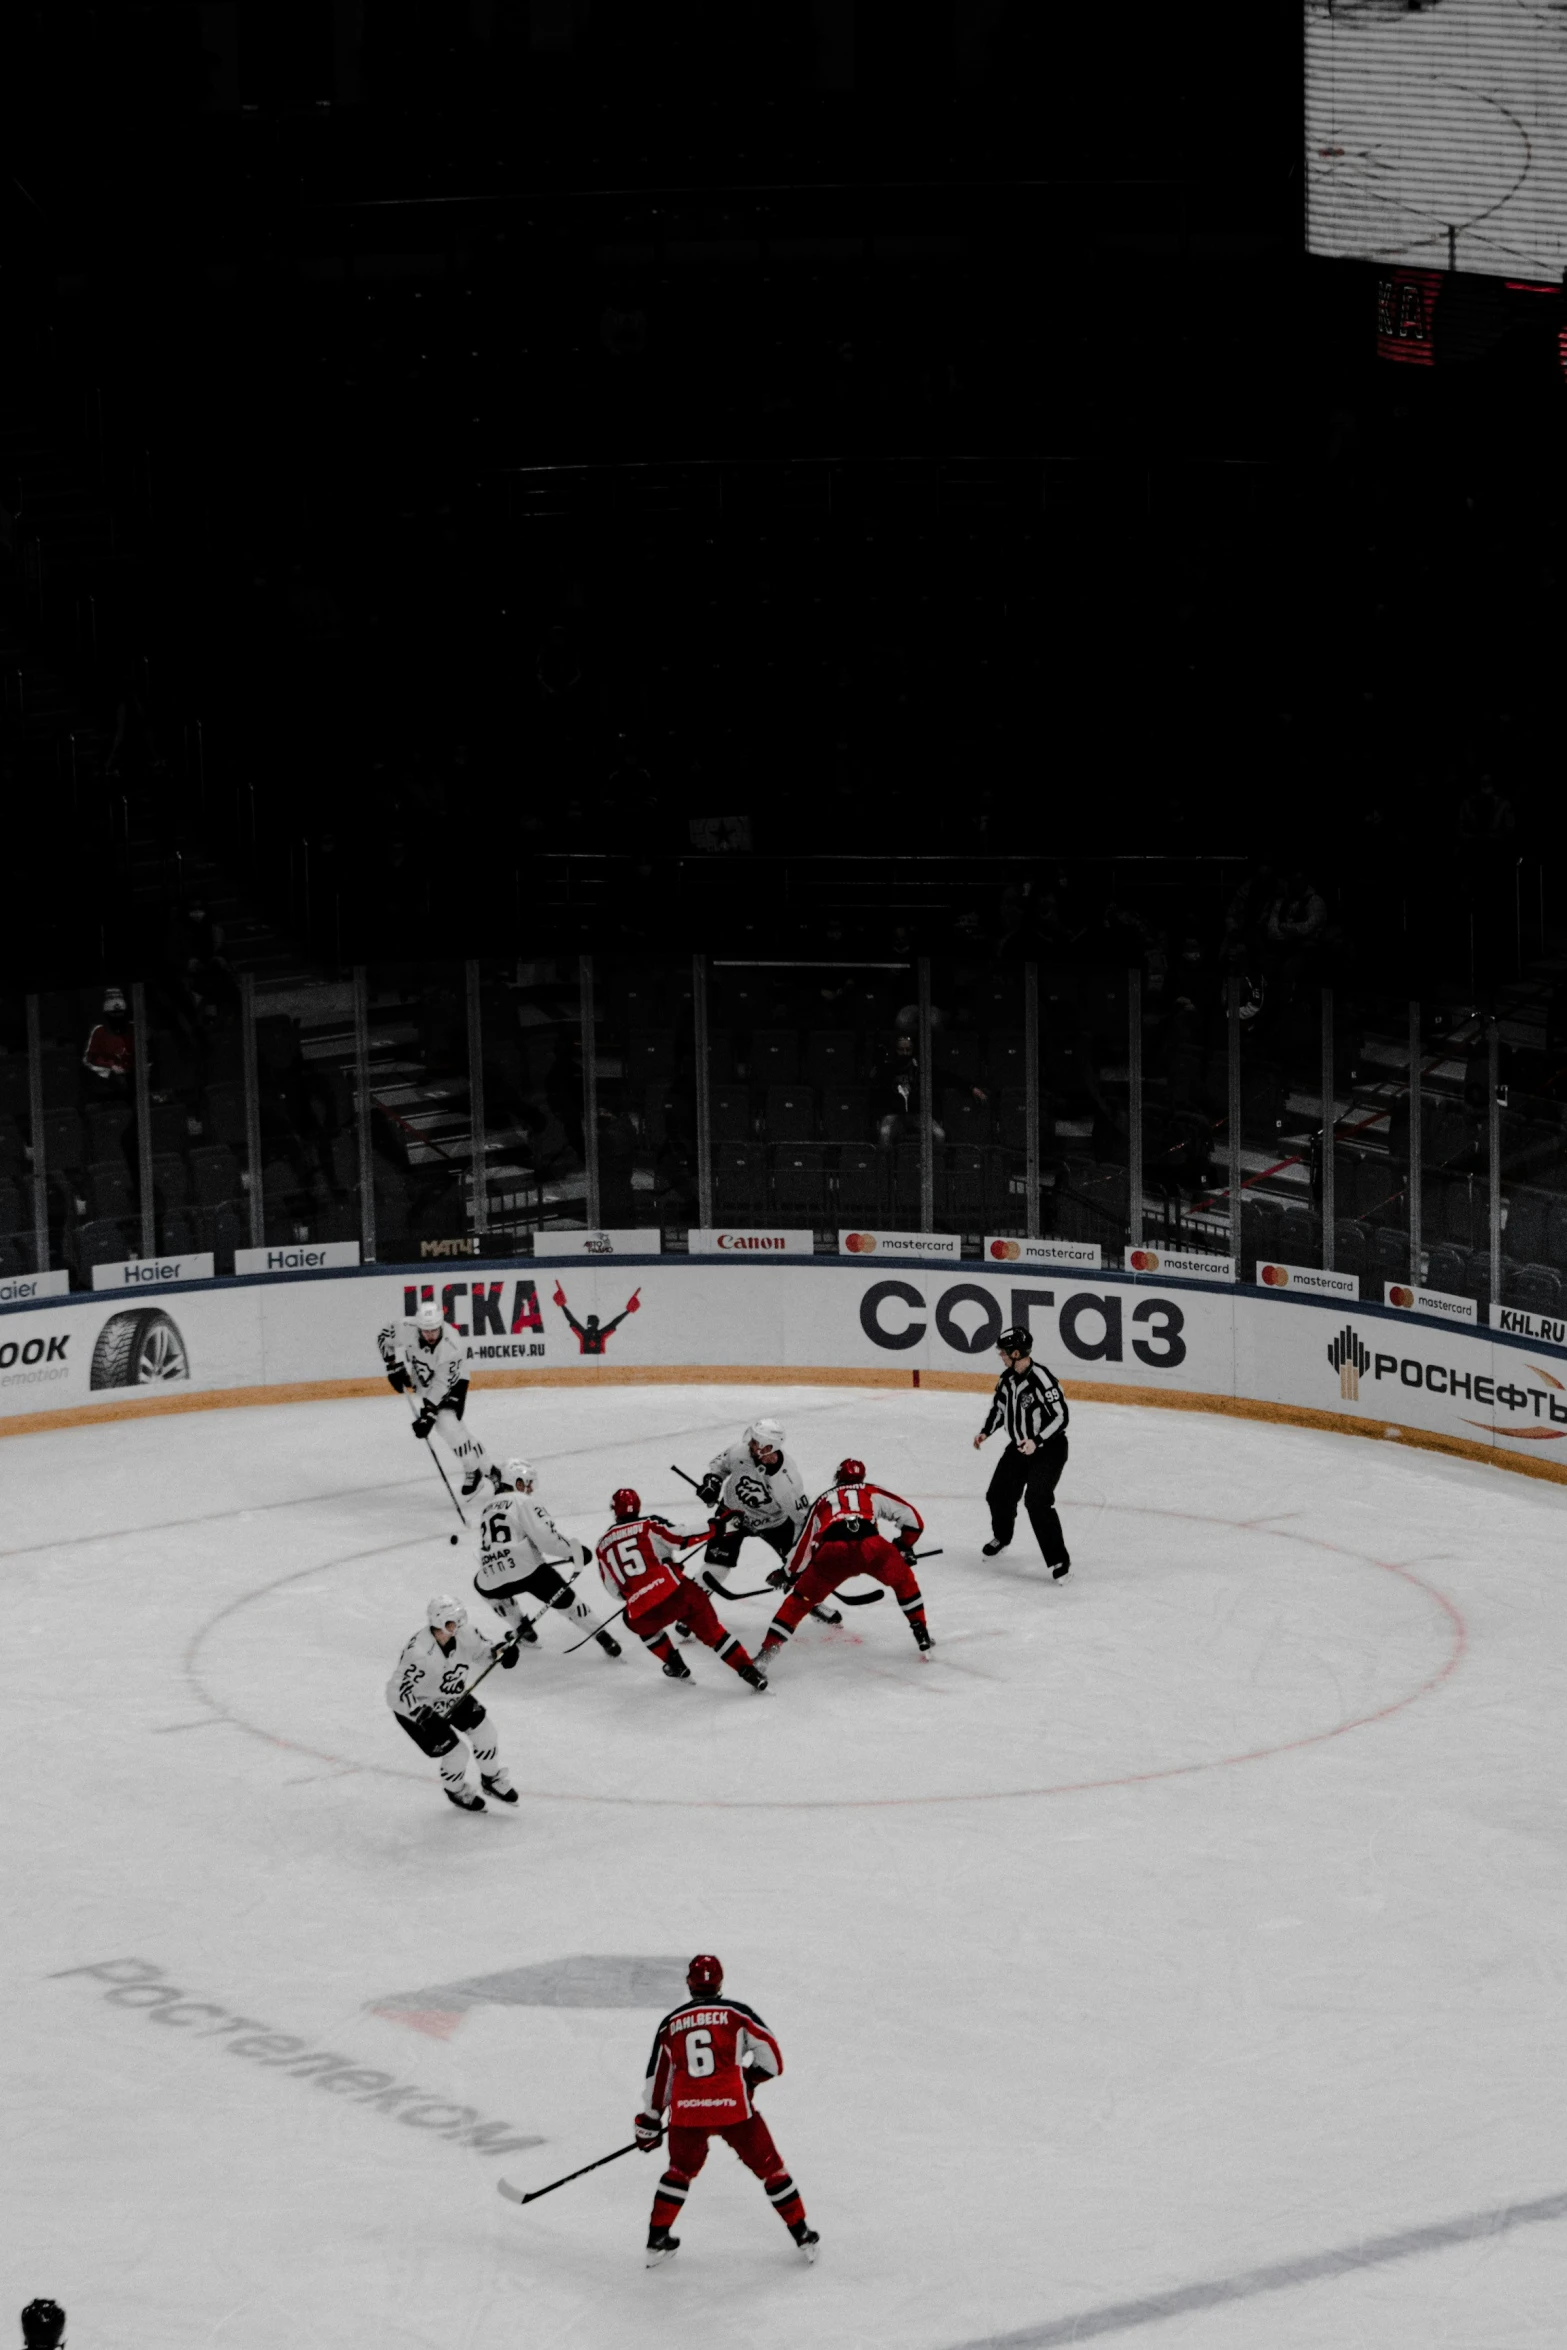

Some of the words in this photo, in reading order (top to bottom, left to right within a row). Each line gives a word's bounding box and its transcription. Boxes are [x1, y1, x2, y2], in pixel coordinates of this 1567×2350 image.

[717, 1234, 786, 1250] Canon
[881, 1237, 955, 1253] mastercard
[267, 1249, 327, 1270] Haier
[1025, 1245, 1095, 1262] mastercard
[124, 1261, 181, 1284] Haier
[1163, 1255, 1230, 1275] mastercard
[1292, 1271, 1354, 1293] mastercard
[1418, 1294, 1473, 1317] mastercard
[1500, 1309, 1566, 1343] KHL.RU
[1, 1366, 70, 1388] emotion
[1044, 1388, 1060, 1403] 99
[1375, 1353, 1567, 1425] РОСНЕФТЬ
[794, 1494, 809, 1512] 40
[825, 1489, 861, 1516] 11
[481, 1548, 511, 1566] ОНАР
[606, 1537, 647, 1586] 15
[404, 1663, 426, 1684] 22
[669, 2009, 729, 2037] DAHLBECK
[684, 2028, 716, 2079] 6
